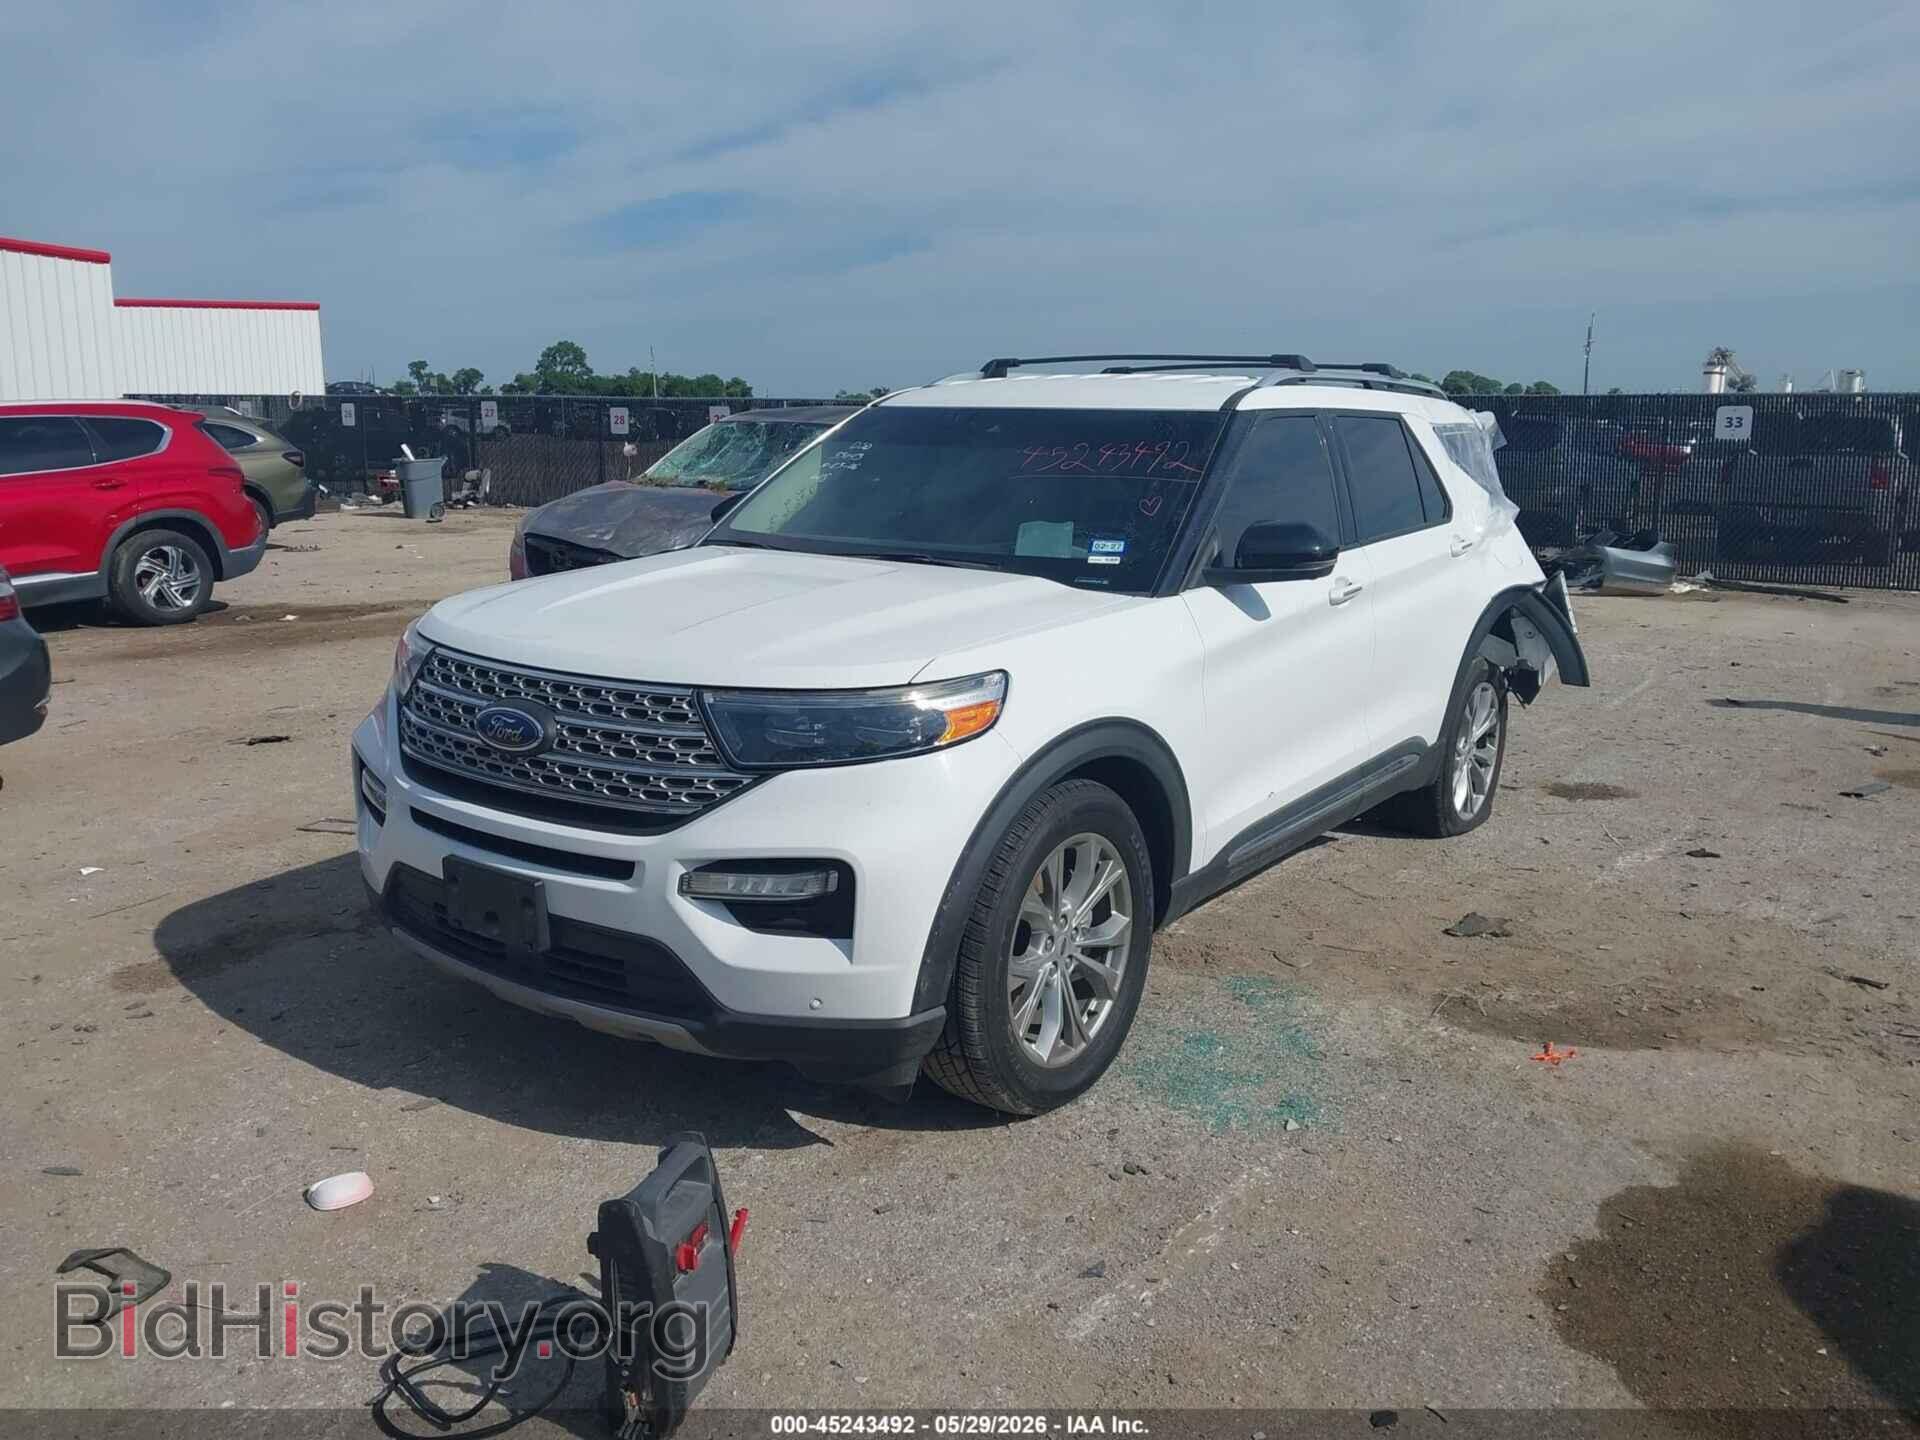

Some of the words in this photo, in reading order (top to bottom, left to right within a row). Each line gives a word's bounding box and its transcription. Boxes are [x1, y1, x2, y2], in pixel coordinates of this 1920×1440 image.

[483, 408, 495, 417] 27
[614, 415, 625, 425] 28
[1723, 416, 1744, 428] 33
[1021, 440, 1203, 473] 45243492
[487, 714, 525, 743] Ford
